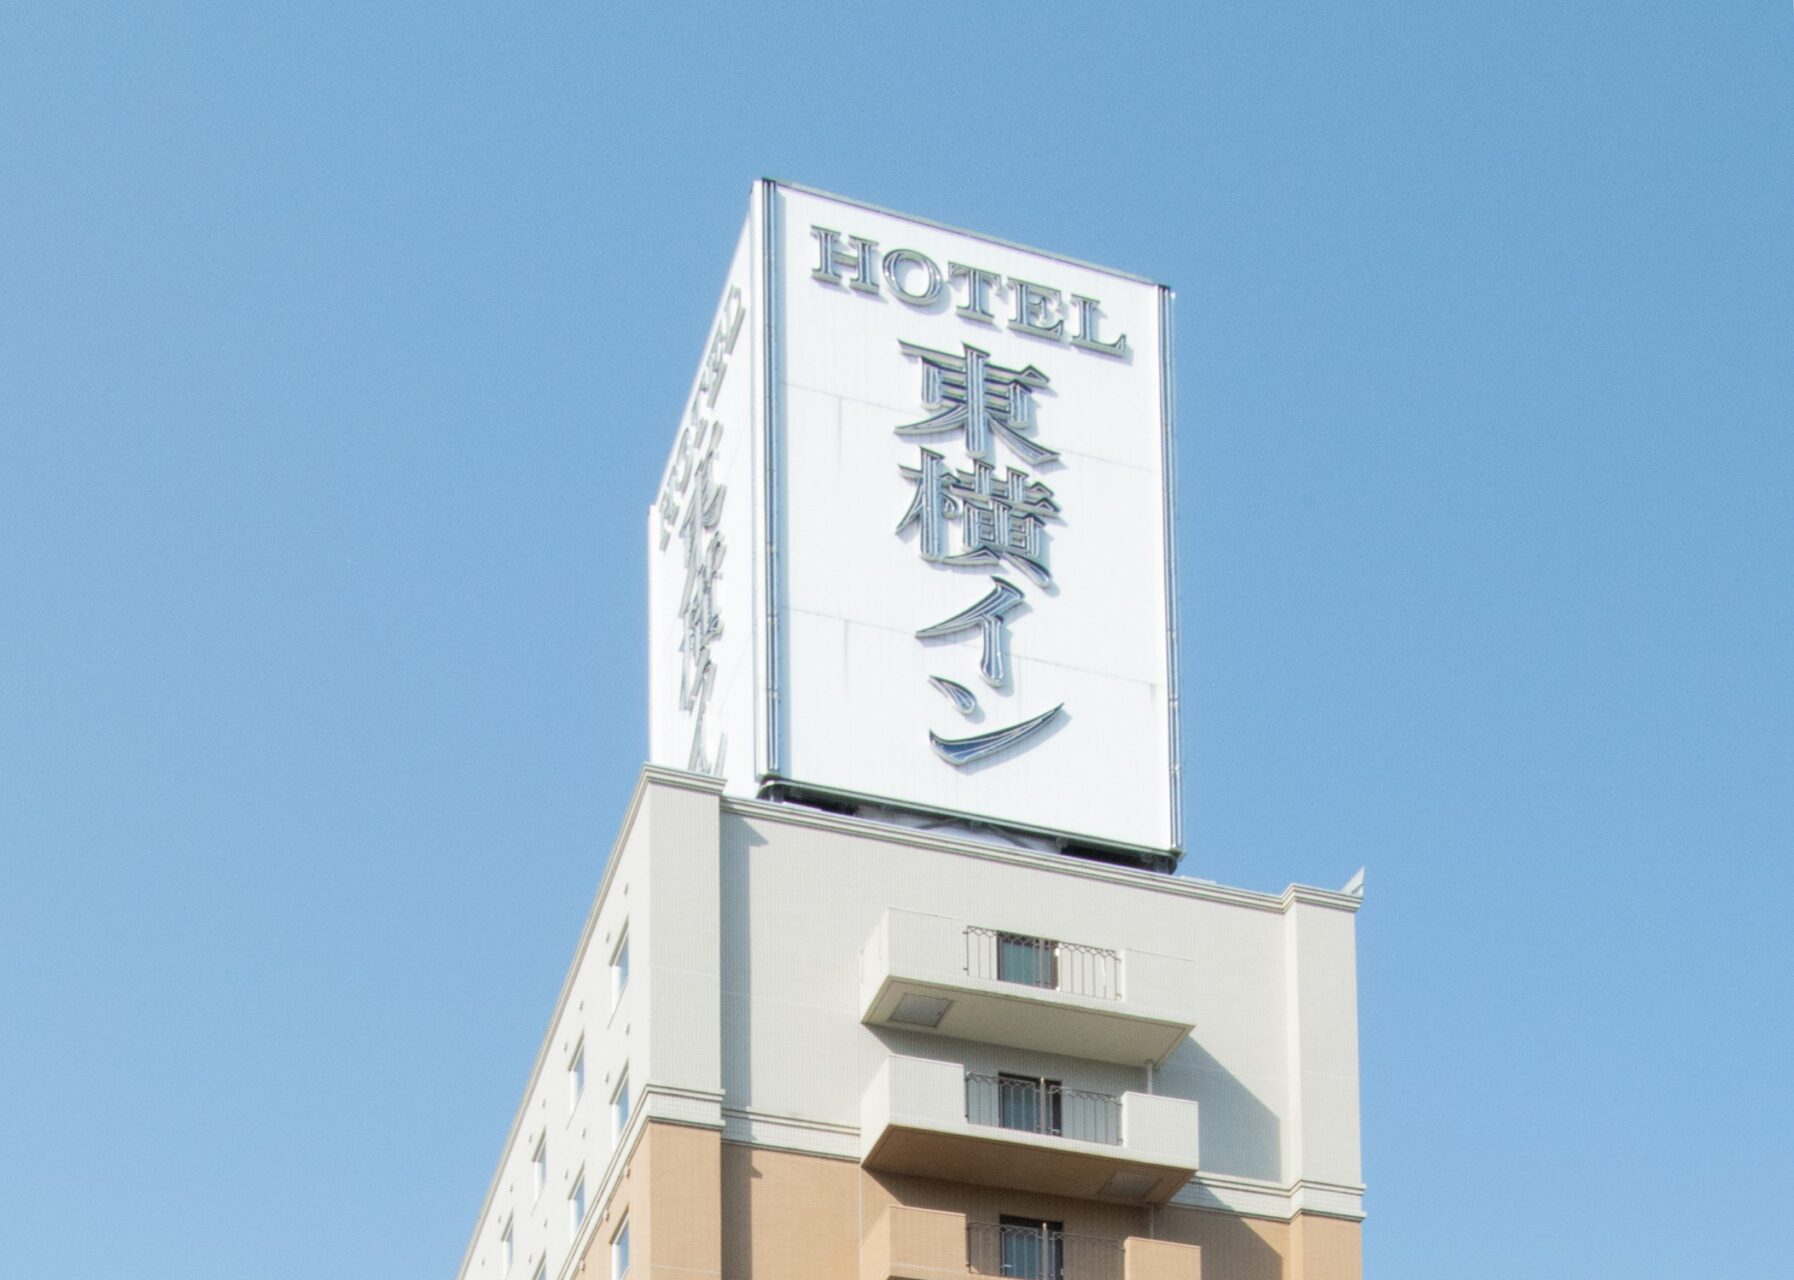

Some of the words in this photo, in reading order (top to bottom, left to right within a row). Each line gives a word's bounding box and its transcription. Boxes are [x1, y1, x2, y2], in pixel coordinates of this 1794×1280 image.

[809, 224, 1127, 358] HOTEL
[893, 337, 1066, 767] 東横イン
